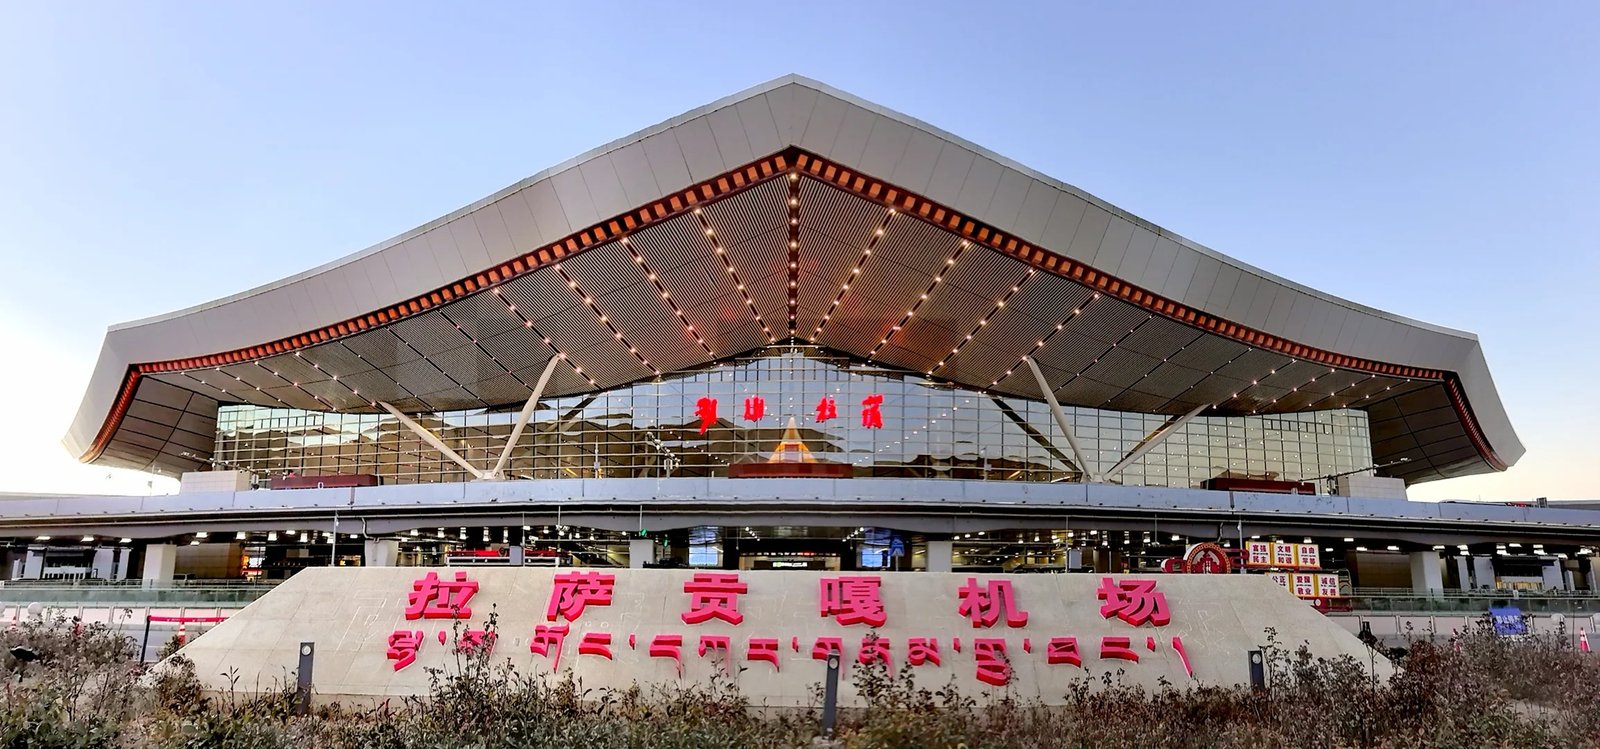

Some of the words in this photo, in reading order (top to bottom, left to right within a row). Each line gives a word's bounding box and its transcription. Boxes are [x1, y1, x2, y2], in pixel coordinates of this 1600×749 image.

[1277, 545, 1291, 553] 文明
[1301, 546, 1315, 554] 自由
[1252, 555, 1267, 563] 民主
[1321, 577, 1336, 585] 诚信
[404, 570, 1172, 629] 拉萨贡嘎机场
